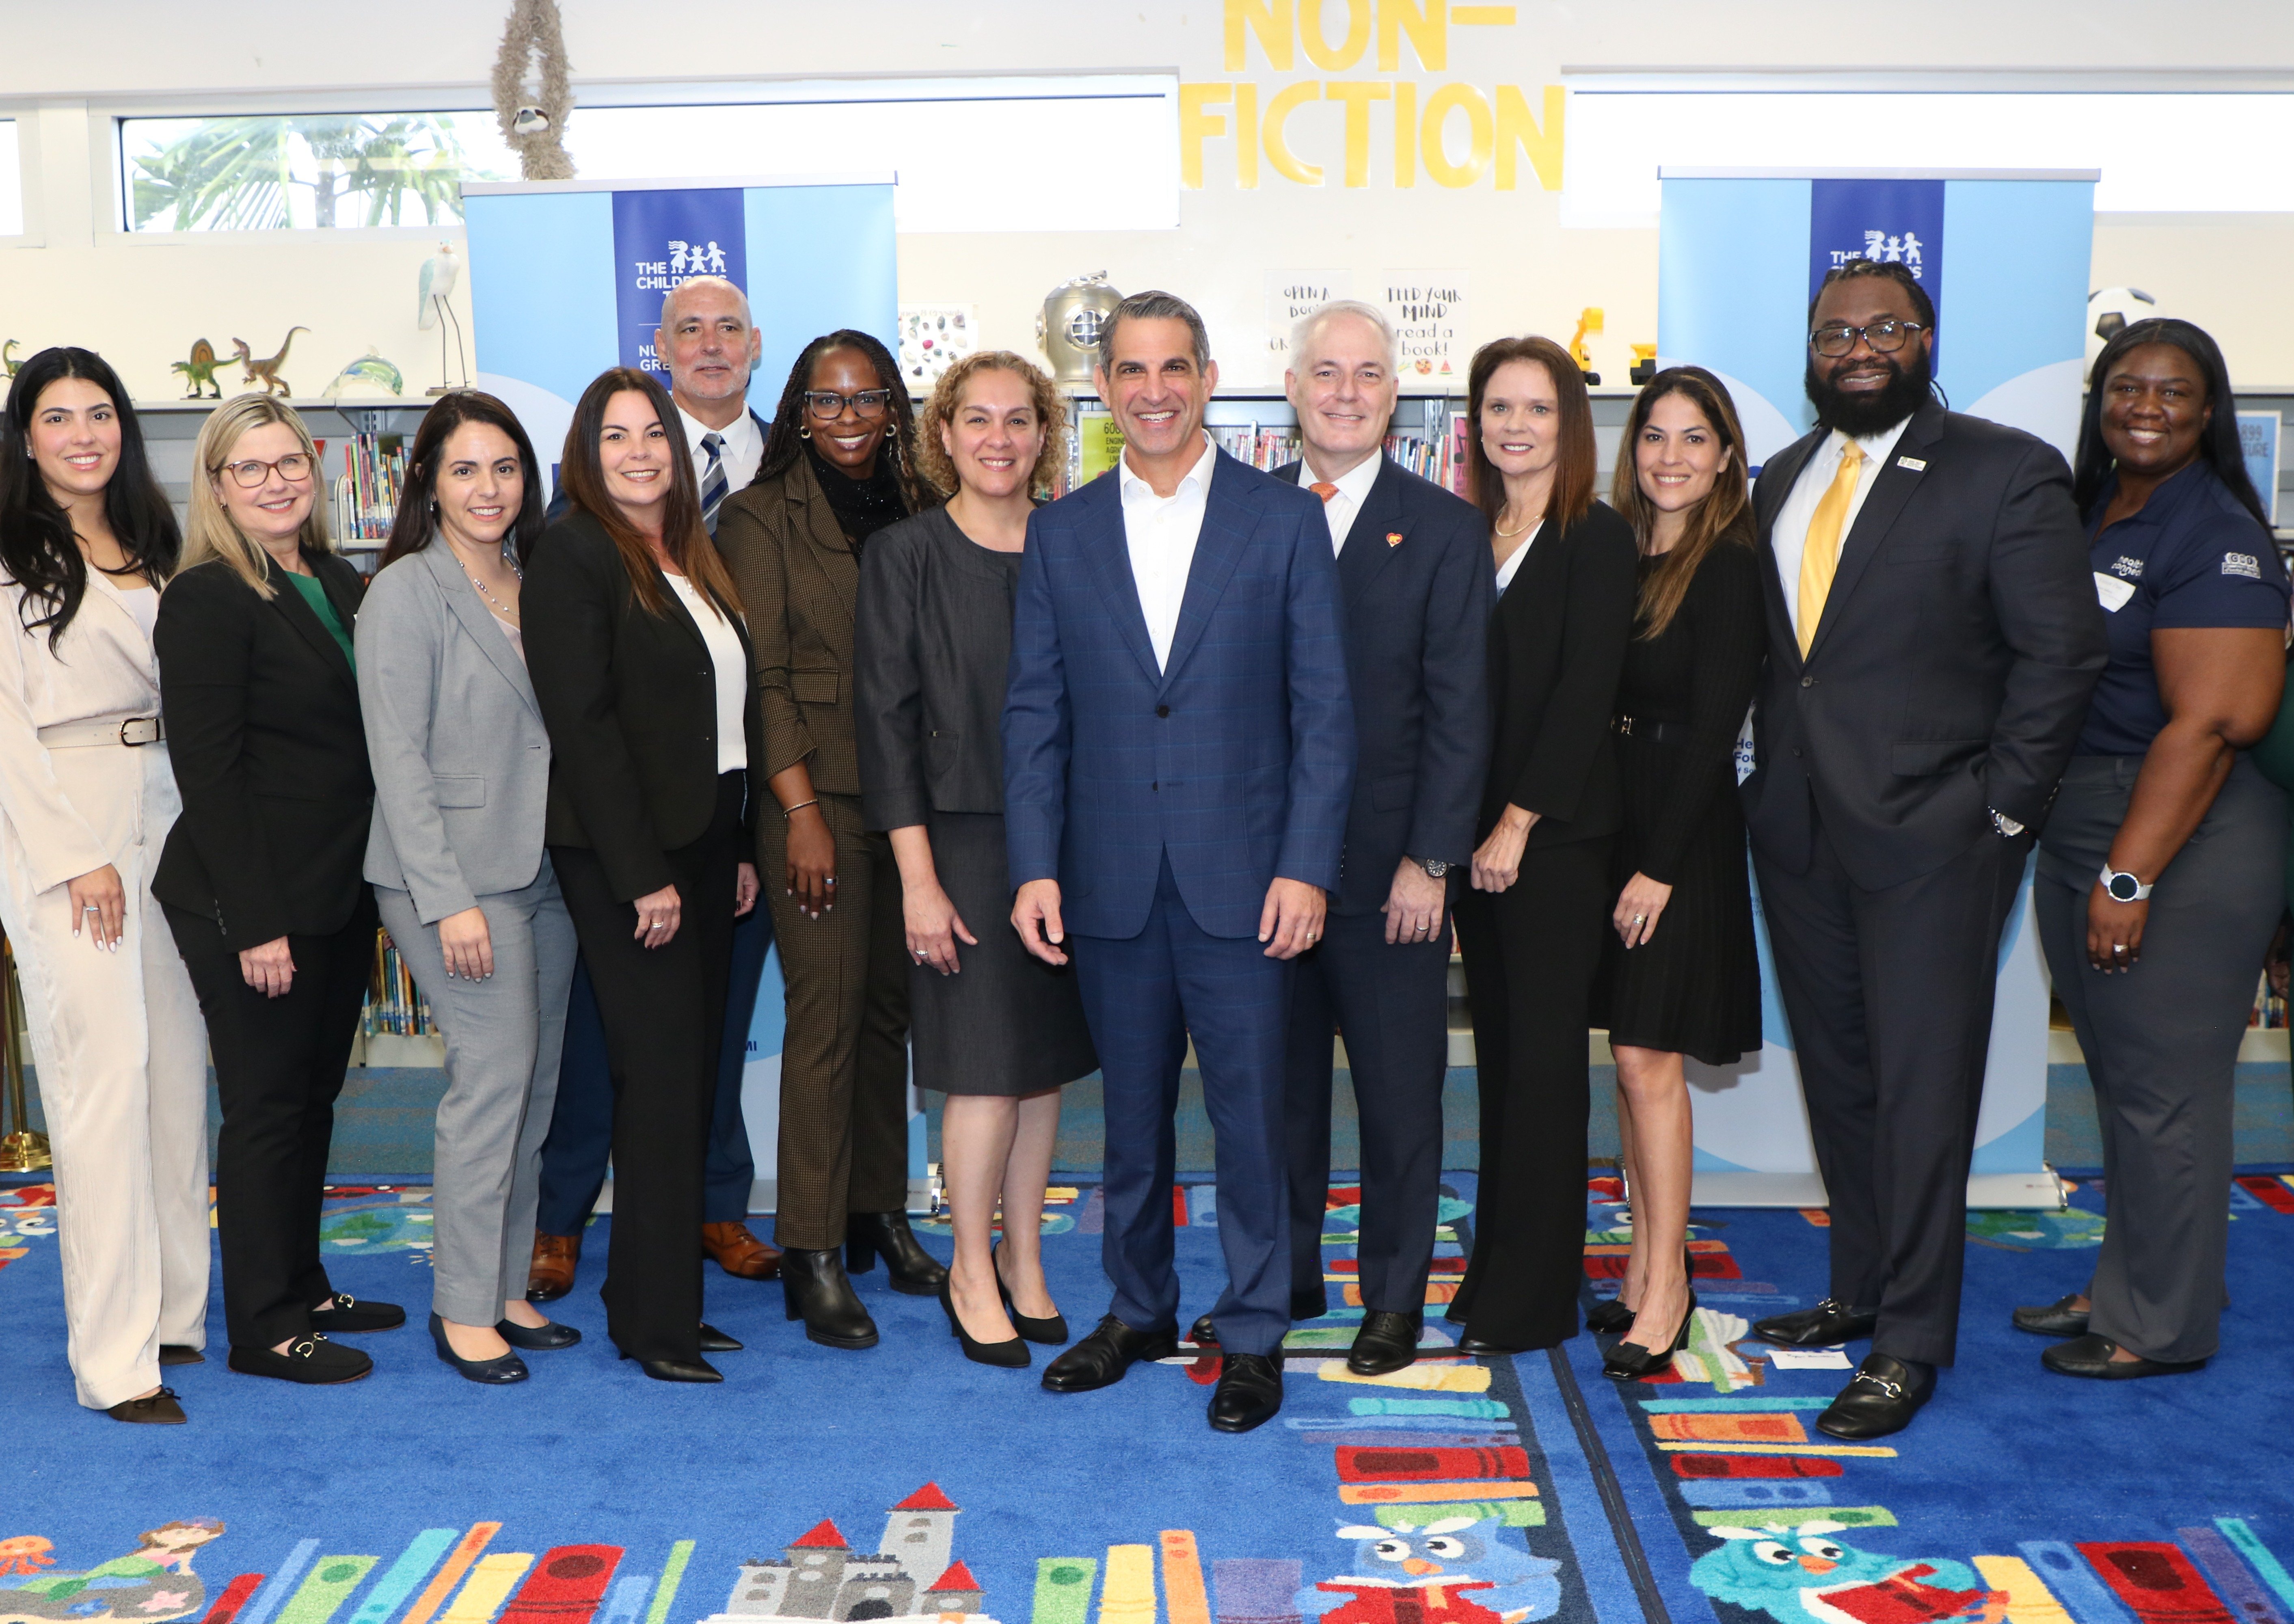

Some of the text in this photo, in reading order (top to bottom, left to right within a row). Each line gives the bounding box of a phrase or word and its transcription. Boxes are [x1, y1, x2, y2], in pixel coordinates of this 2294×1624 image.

[1223, 0, 1516, 72] NON-
[1179, 80, 1566, 191] FICTION
[1830, 251, 1862, 264] THE
[635, 262, 667, 274] THE
[1284, 286, 1330, 301] OPEN A
[1389, 287, 1461, 303] FEED YOUR
[1290, 304, 1318, 318] BOO
[1403, 303, 1447, 322] MIND
[1397, 323, 1452, 338] read a
[1402, 341, 1447, 356] book!
